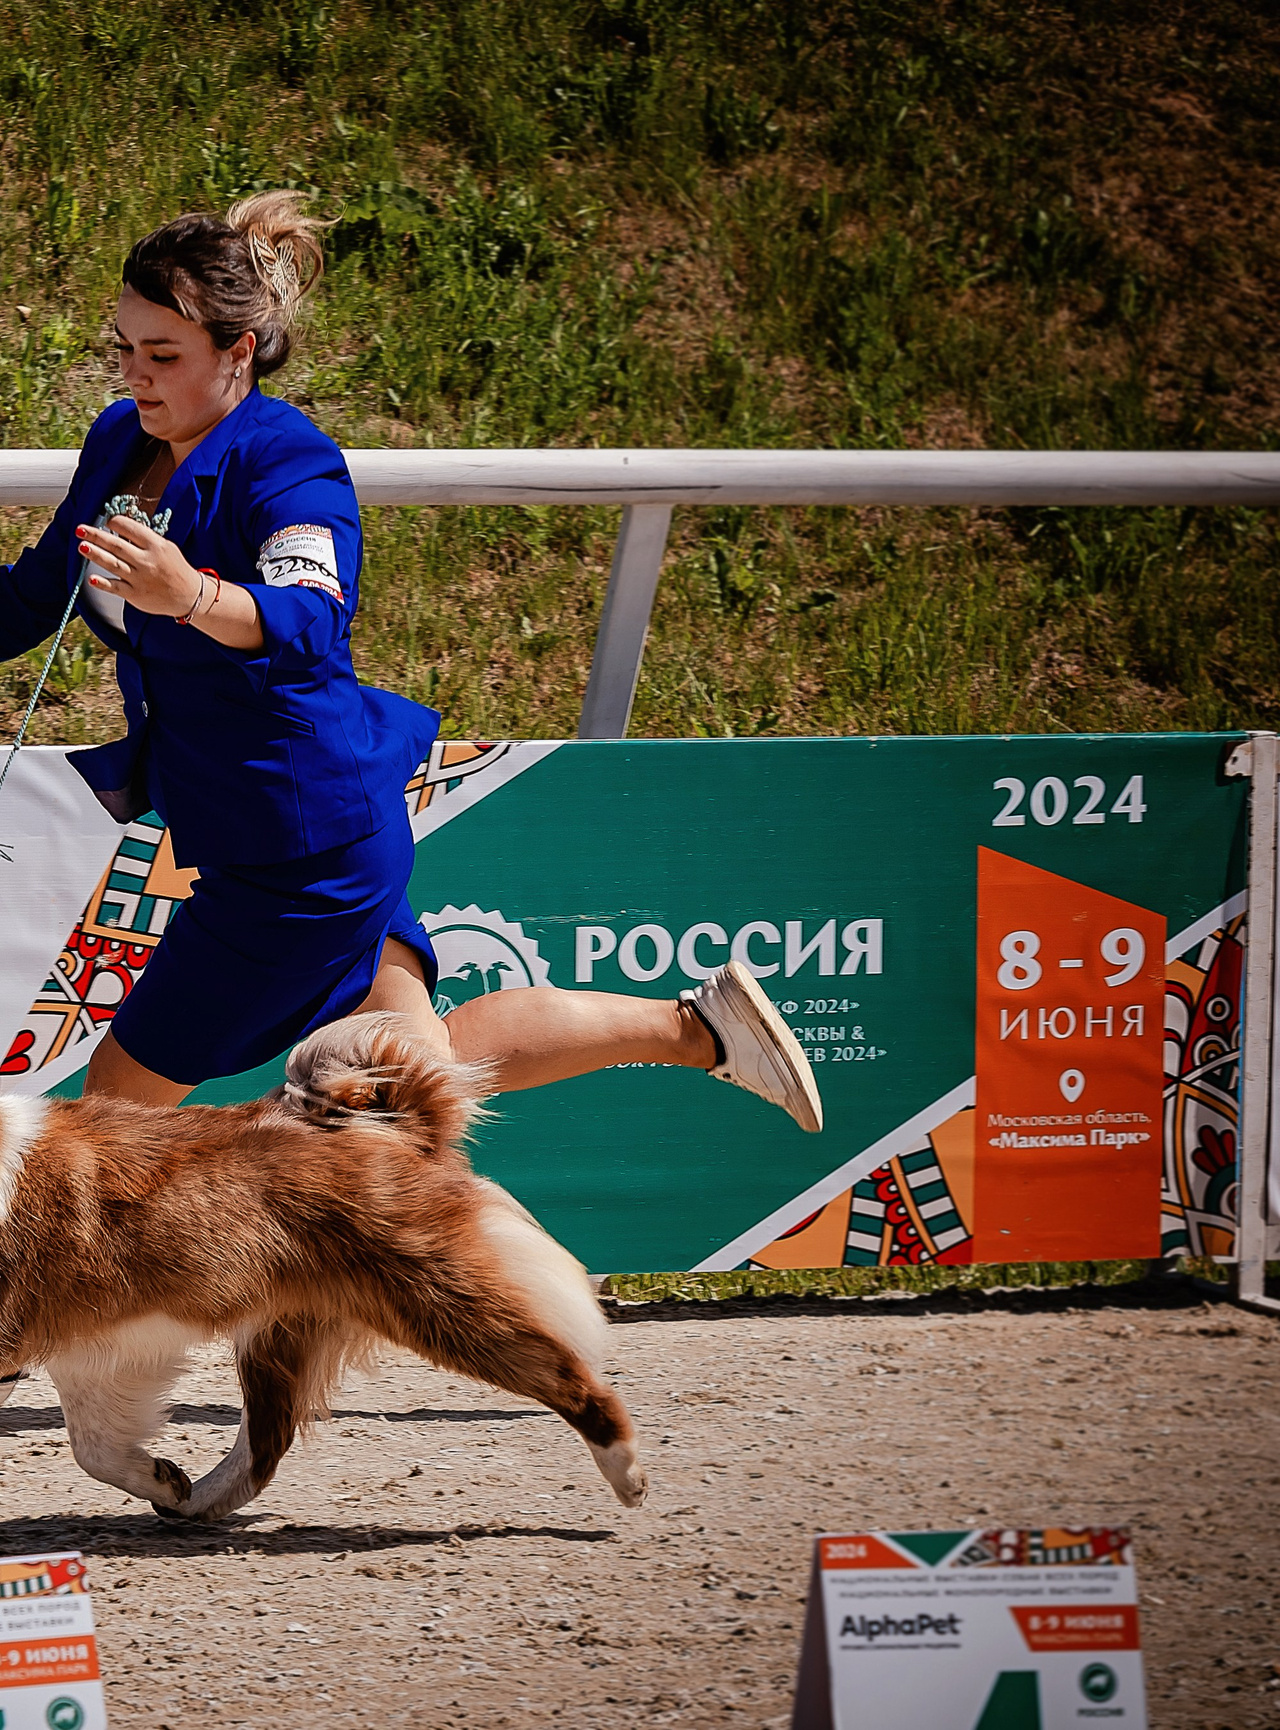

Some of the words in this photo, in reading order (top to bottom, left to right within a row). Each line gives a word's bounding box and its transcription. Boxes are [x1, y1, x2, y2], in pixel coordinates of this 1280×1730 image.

[991, 775, 1148, 827] 2024
[573, 917, 884, 984] РОССИЯ
[770, 1000, 800, 1015] КФ
[803, 998, 861, 1015] 2024»
[999, 1004, 1145, 1041] ИЮНЯ
[791, 1026, 846, 1042] СКВЫ
[850, 1025, 866, 1041] &
[831, 1045, 888, 1062] 2024»
[987, 1113, 1083, 1128] Московская
[988, 1131, 1087, 1149] «Максима
[1090, 1128, 1151, 1150] Парк»
[839, 1612, 964, 1642] AlphaPet
[25, 1644, 89, 1665] ИЮНЯ
